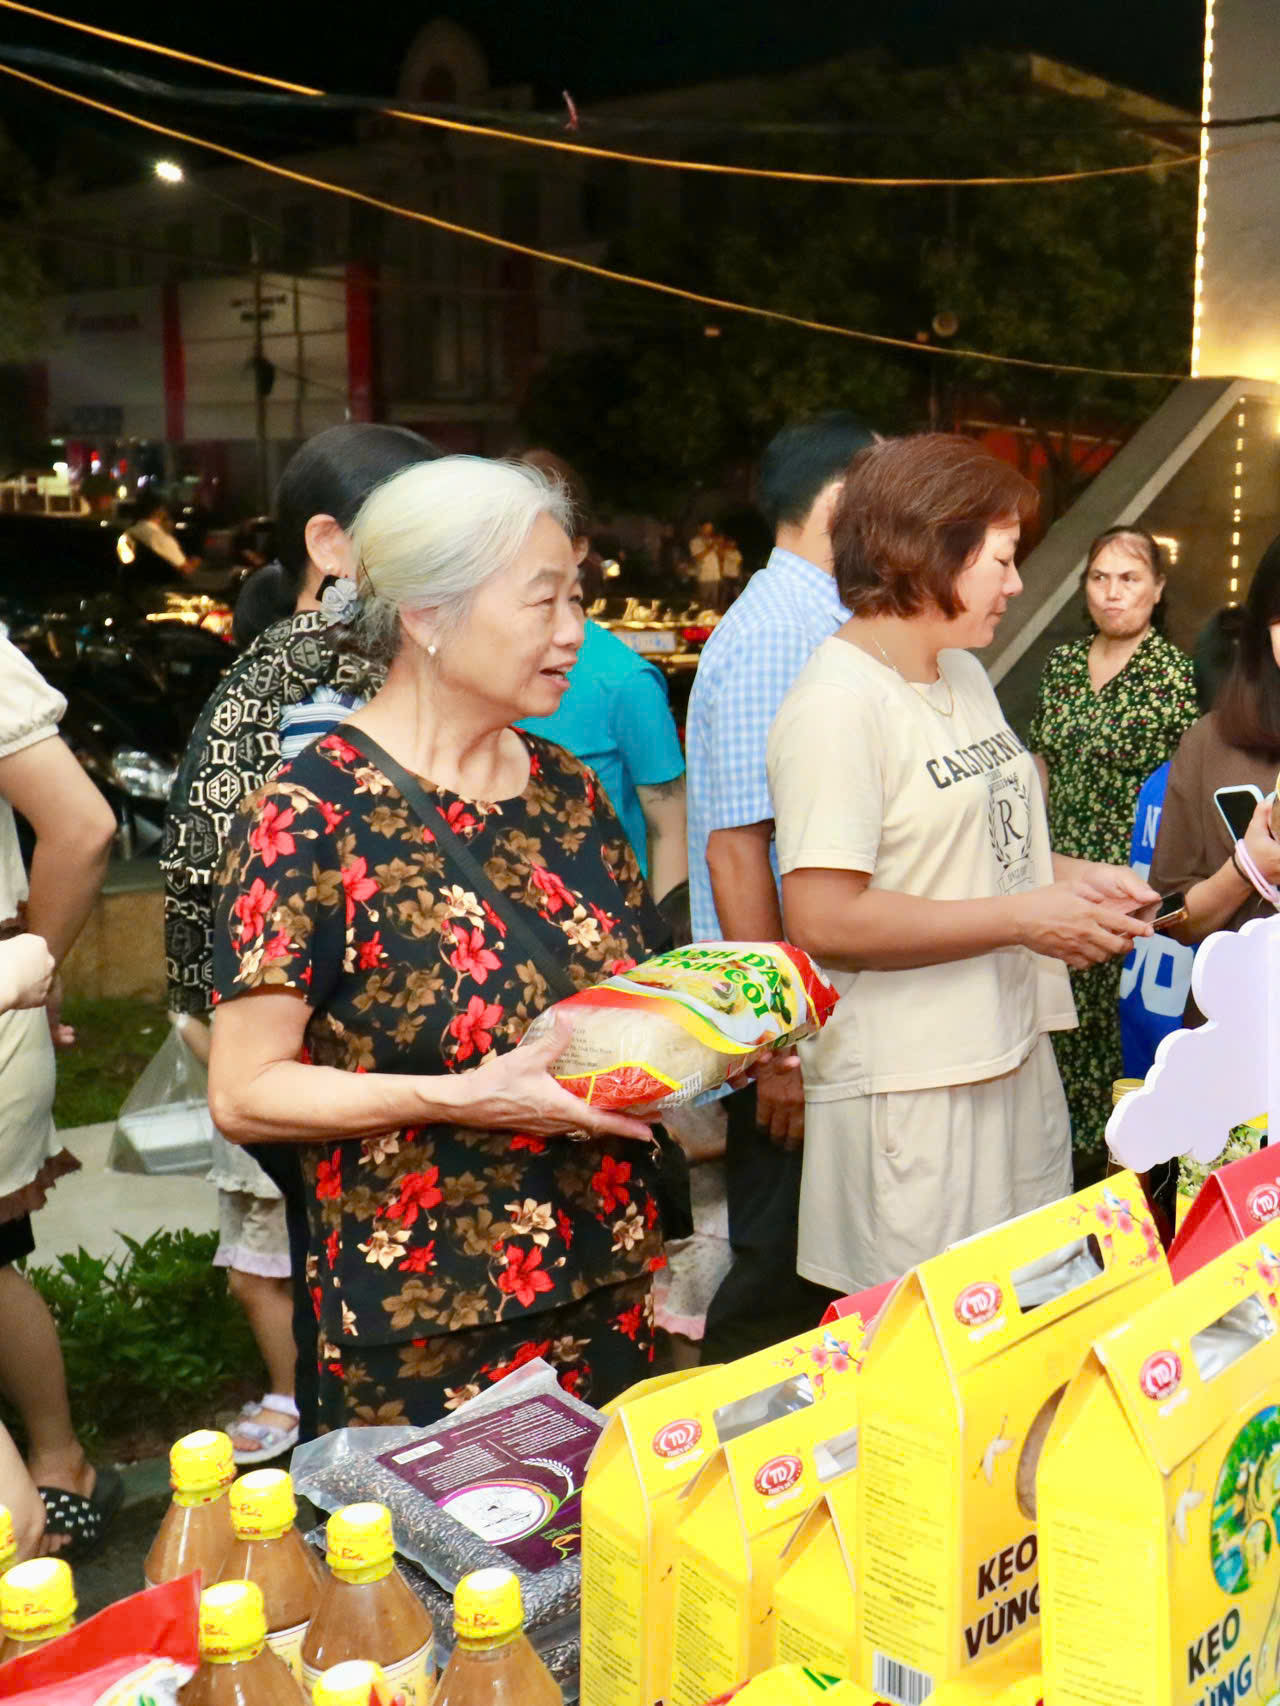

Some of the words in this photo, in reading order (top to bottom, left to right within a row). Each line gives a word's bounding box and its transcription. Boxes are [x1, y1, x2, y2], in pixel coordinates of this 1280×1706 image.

[998, 800, 1024, 847] R
[977, 1533, 1038, 1601] KẸO
[1188, 1608, 1241, 1685] KẸO
